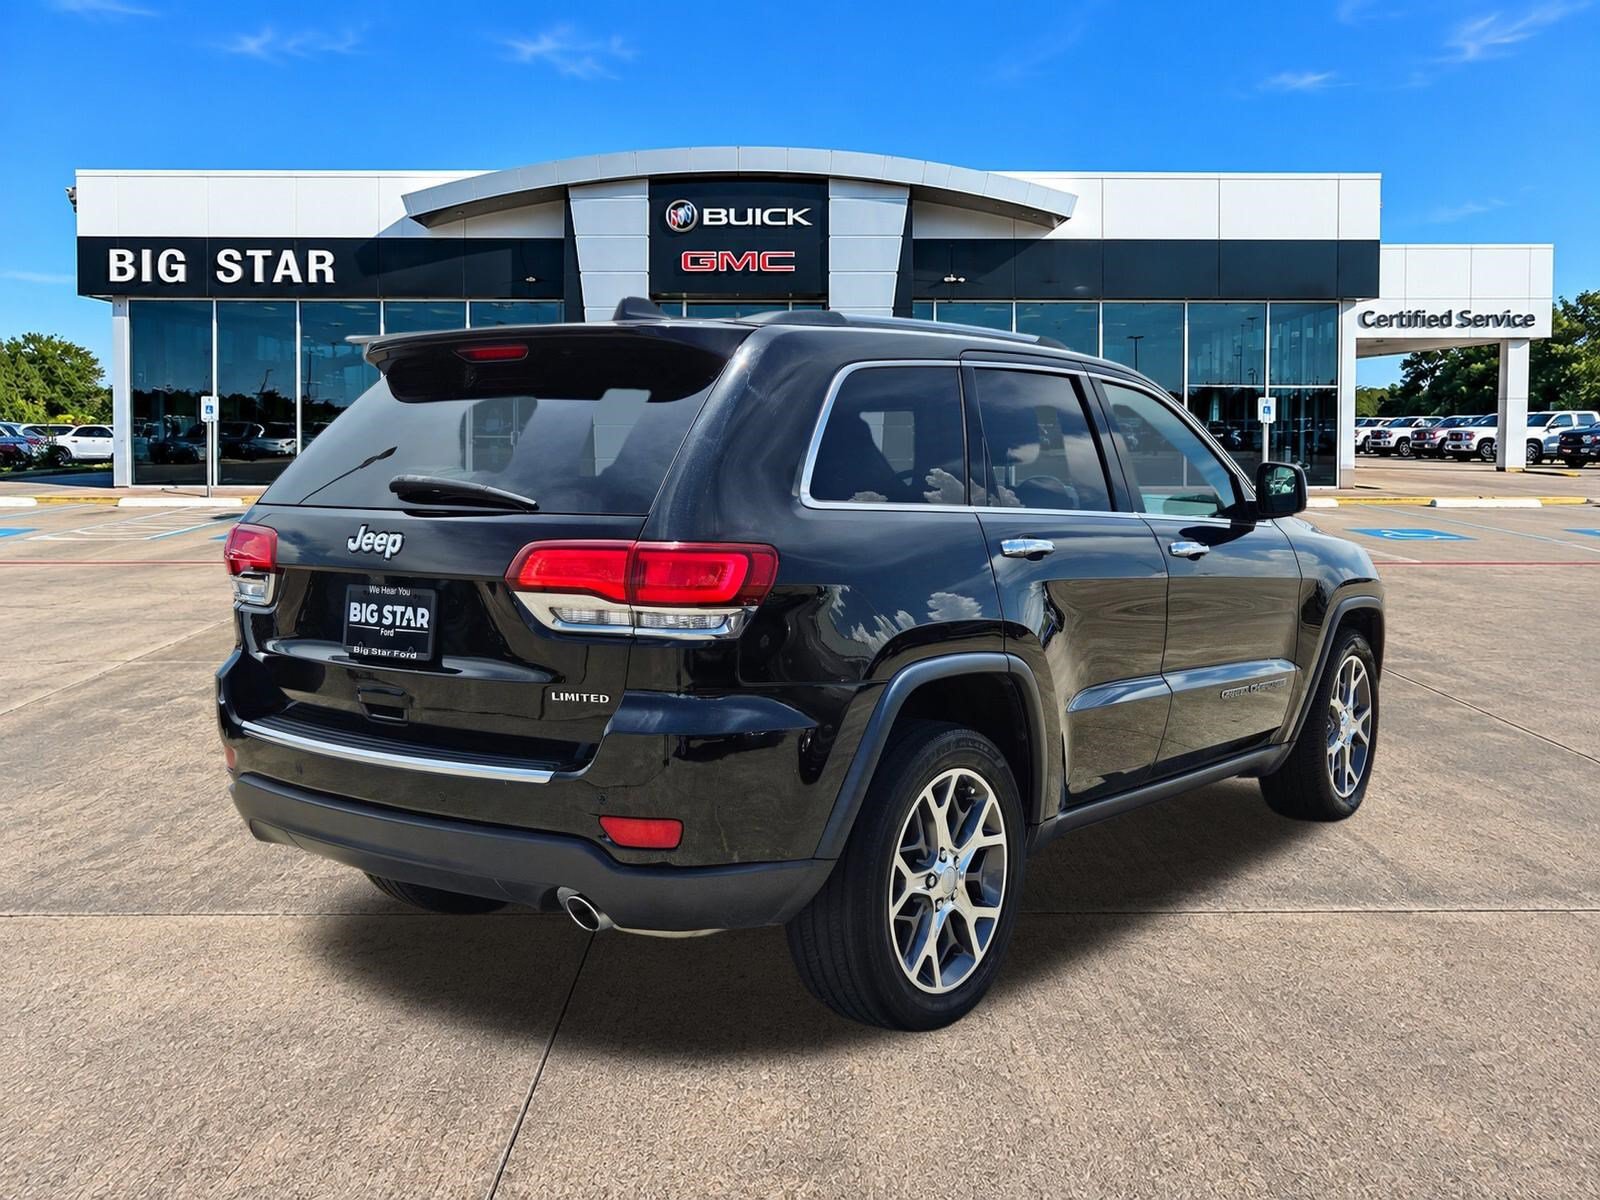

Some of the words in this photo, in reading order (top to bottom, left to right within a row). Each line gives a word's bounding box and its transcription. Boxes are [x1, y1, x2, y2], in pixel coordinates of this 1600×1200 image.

[702, 207, 814, 226] BUICK
[108, 248, 187, 283] BIG
[216, 248, 335, 283] STAR
[681, 250, 796, 272] GMC
[1358, 309, 1452, 329] Certified
[1455, 309, 1536, 329] Service
[347, 524, 404, 560] Jeep
[369, 585, 380, 594] We
[381, 586, 397, 596] Hear
[398, 587, 411, 596] You
[349, 602, 379, 624] BIG
[381, 604, 430, 628] STAR
[380, 628, 395, 637] Ford
[353, 646, 369, 656] Big
[371, 648, 391, 657] Star
[393, 650, 417, 659] Ford
[551, 691, 610, 704] LIMITED
